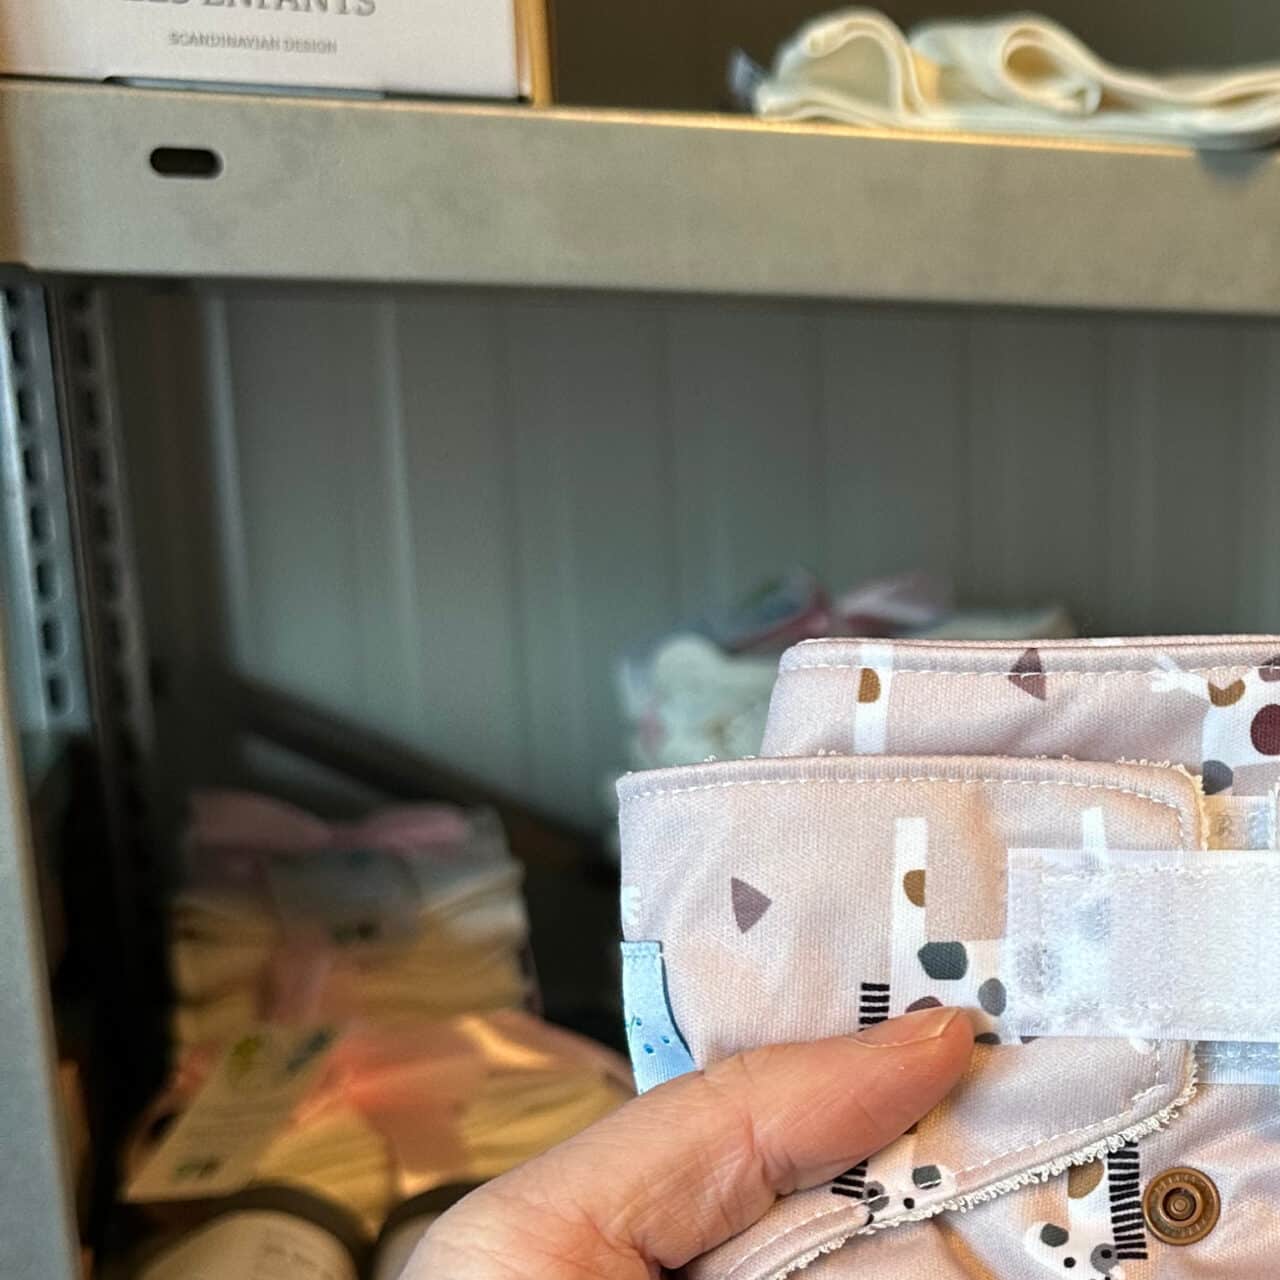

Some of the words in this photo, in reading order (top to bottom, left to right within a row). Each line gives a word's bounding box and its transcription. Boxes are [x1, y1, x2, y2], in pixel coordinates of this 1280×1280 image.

[200, 0, 377, 17] ANTS
[168, 31, 281, 49] SCANDINAVIAN
[283, 38, 338, 53] DESIGN
